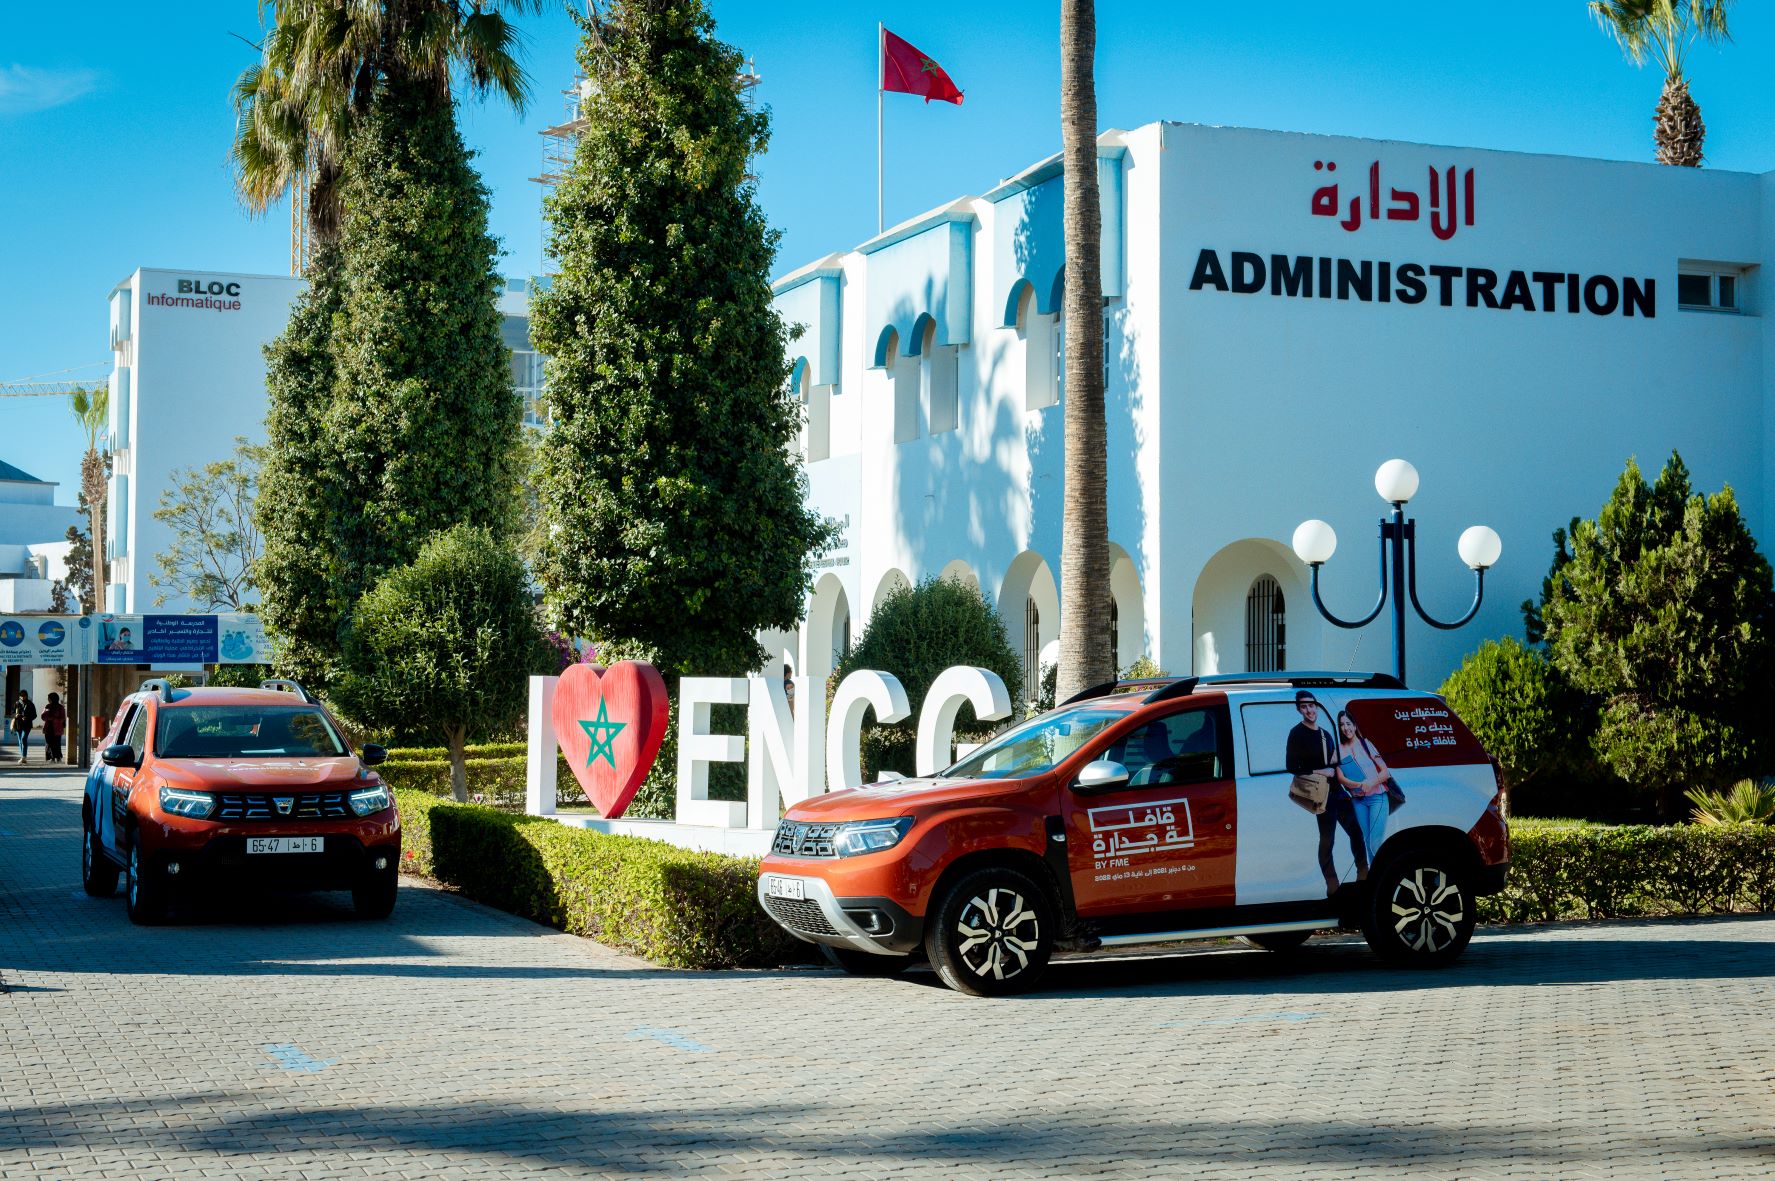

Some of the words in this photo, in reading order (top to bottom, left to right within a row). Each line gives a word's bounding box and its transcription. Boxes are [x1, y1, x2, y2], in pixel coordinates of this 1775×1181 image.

[1311, 160, 1475, 241] الادارة
[178, 279, 241, 297] BLOC
[1189, 247, 1656, 318] ADMINISTRATION
[147, 292, 241, 312] Informatique
[1394, 709, 1410, 721] بين
[1411, 708, 1449, 720] مستقبلك
[1415, 725, 1427, 734] مع
[1428, 722, 1454, 734] يديك
[1406, 737, 1432, 749] جدارة
[1432, 736, 1457, 746] قافلة
[311, 838, 317, 852] 6
[1095, 860, 1107, 870] BY
[1109, 858, 1130, 868] FME
